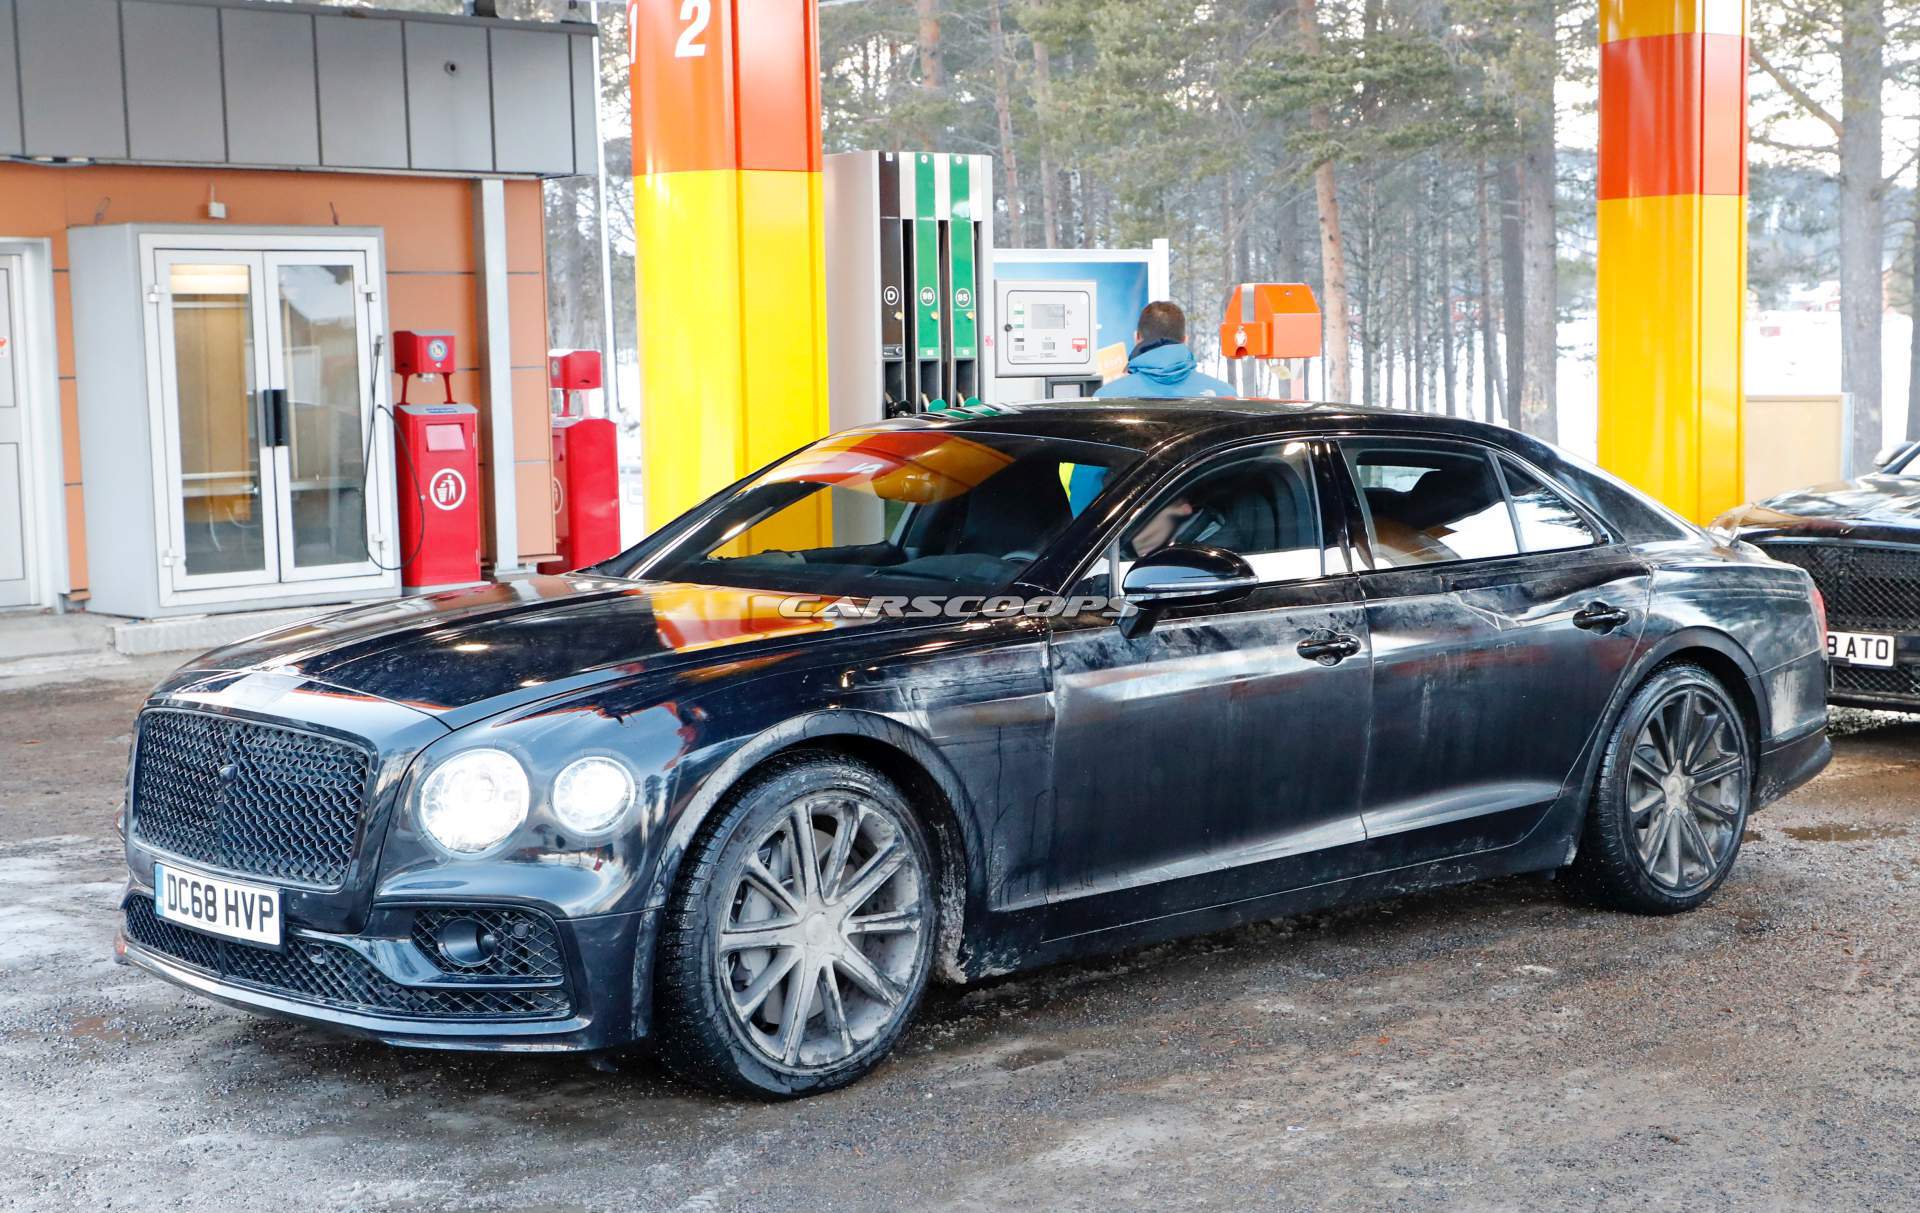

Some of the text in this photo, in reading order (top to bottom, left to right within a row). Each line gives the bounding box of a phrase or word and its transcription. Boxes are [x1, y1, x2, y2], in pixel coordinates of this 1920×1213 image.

[674, 0, 711, 57] 2
[1845, 636, 1889, 660] ATO
[167, 873, 274, 932] DC68 HVP
